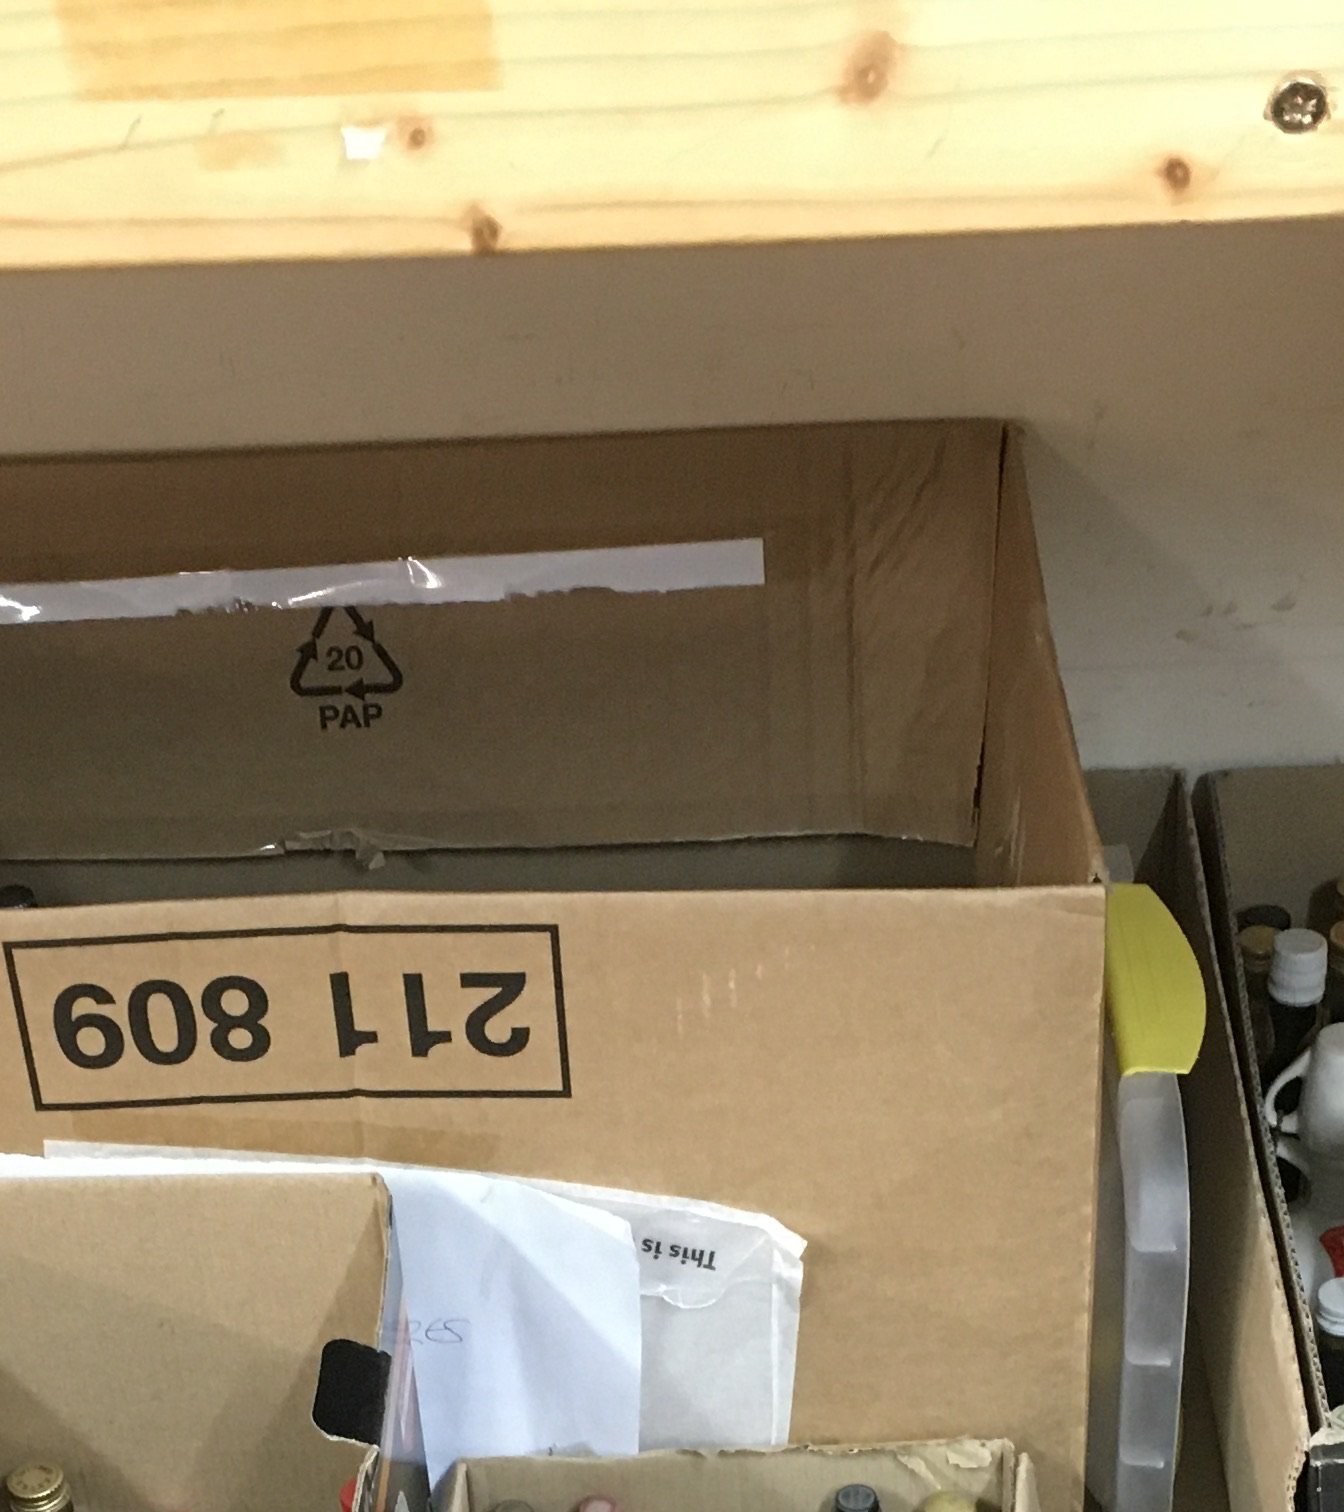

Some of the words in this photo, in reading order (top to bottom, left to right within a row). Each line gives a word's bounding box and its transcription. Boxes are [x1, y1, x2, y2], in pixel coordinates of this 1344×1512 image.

[326, 645, 364, 671] 20
[319, 703, 383, 730] PAP
[53, 975, 271, 1069] 809
[329, 971, 532, 1058] 211
[641, 1238, 662, 1259] is
[669, 1244, 716, 1270] This
